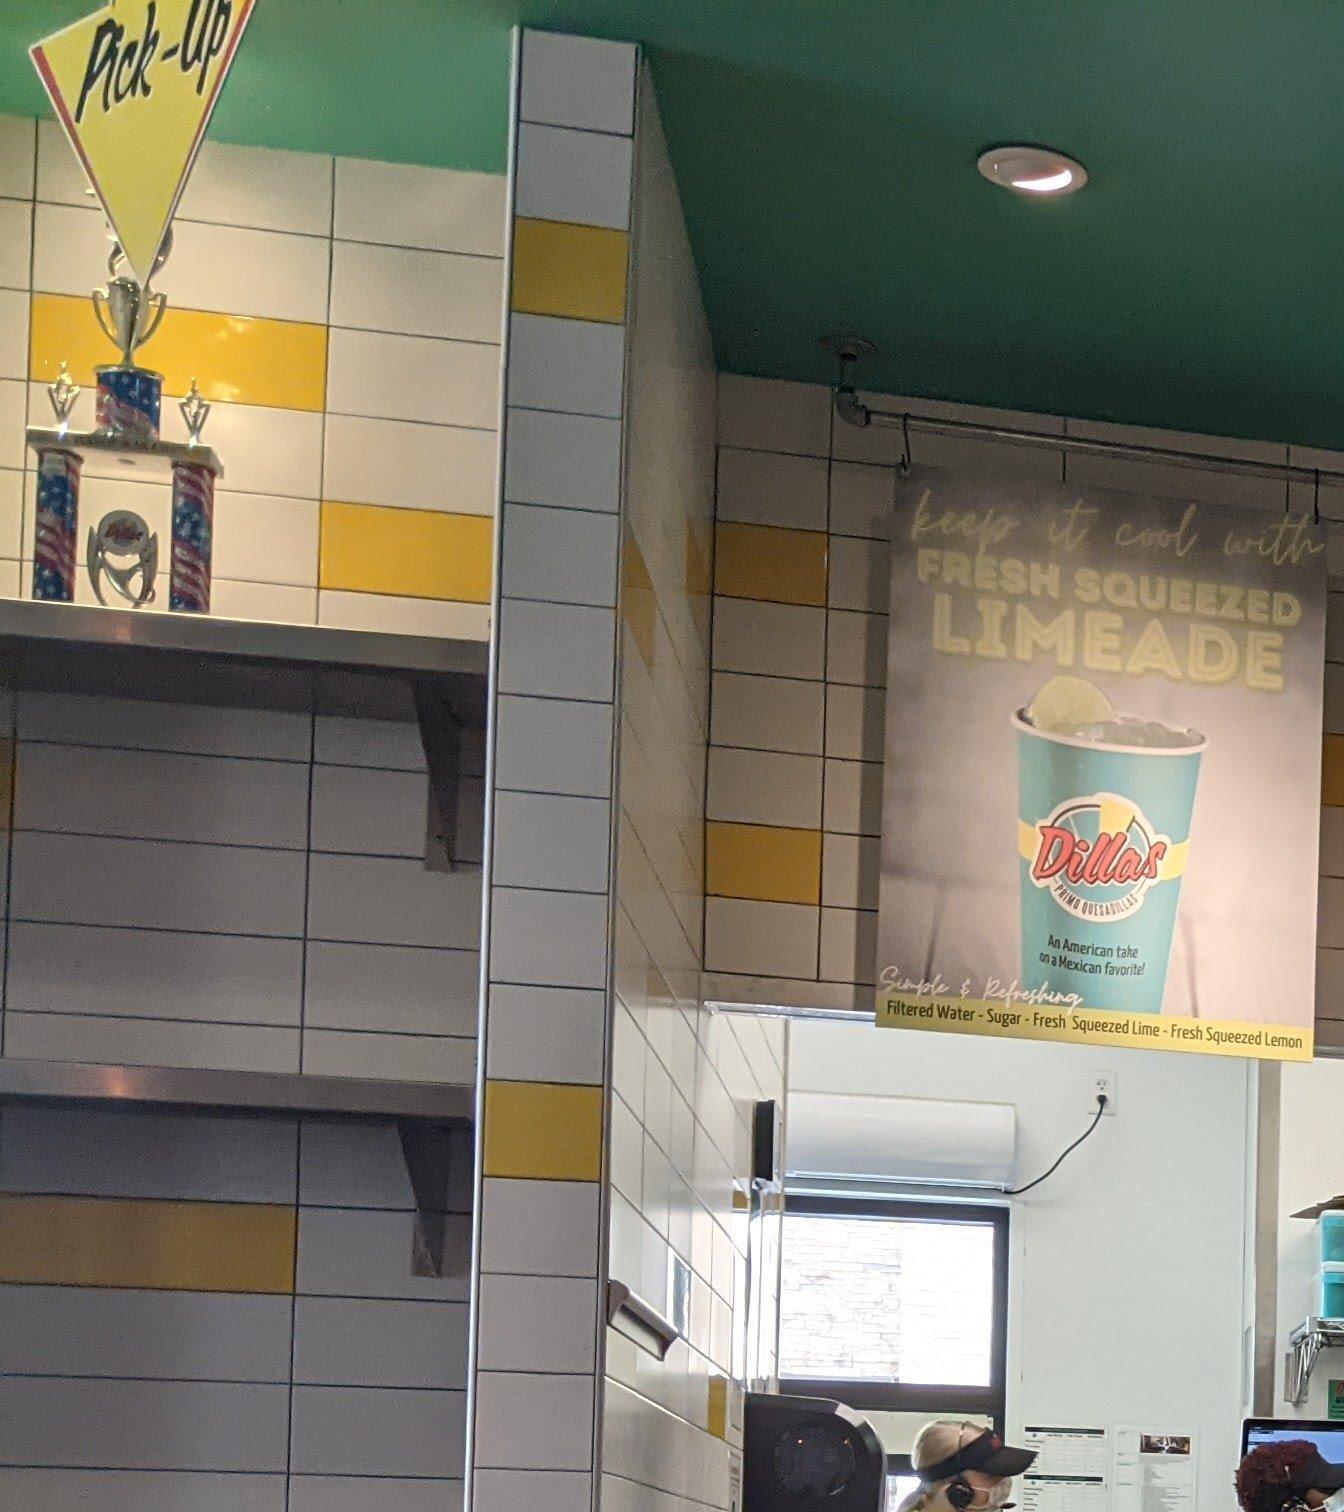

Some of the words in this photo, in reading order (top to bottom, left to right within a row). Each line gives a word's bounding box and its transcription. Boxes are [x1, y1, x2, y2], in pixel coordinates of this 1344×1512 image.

[75, 0, 231, 123] Pick-Up
[911, 489, 1020, 561] keep
[1047, 501, 1098, 551] it
[1116, 504, 1198, 557] cool
[1224, 512, 1325, 565] with
[917, 549, 1060, 598] FRESH
[1075, 568, 1301, 627] SQUEEZED
[932, 593, 1284, 691] LIMEADE
[1033, 825, 1166, 885] Dillas
[1054, 885, 1080, 912] PRIMO
[1081, 893, 1138, 917] QUESADILLAS
[1039, 953, 1050, 963] on
[1059, 955, 1102, 974] Mexican
[1104, 960, 1145, 976] favorite!
[1047, 935, 1061, 949] An
[1063, 938, 1114, 958] American
[1116, 944, 1138, 959] take
[879, 966, 950, 996] Simple
[984, 978, 1083, 1017] Refreshing
[887, 1001, 933, 1019] Filtered
[937, 1005, 974, 1022] Water
[987, 1009, 1021, 1028] Sugar
[1033, 1011, 1066, 1029] Fresh
[1073, 1015, 1128, 1037] Squeezed
[1132, 1018, 1159, 1037] Lime
[1170, 1023, 1203, 1041] Fresh
[1205, 1026, 1261, 1047] Squeezed
[1265, 1031, 1302, 1049] Lemon
